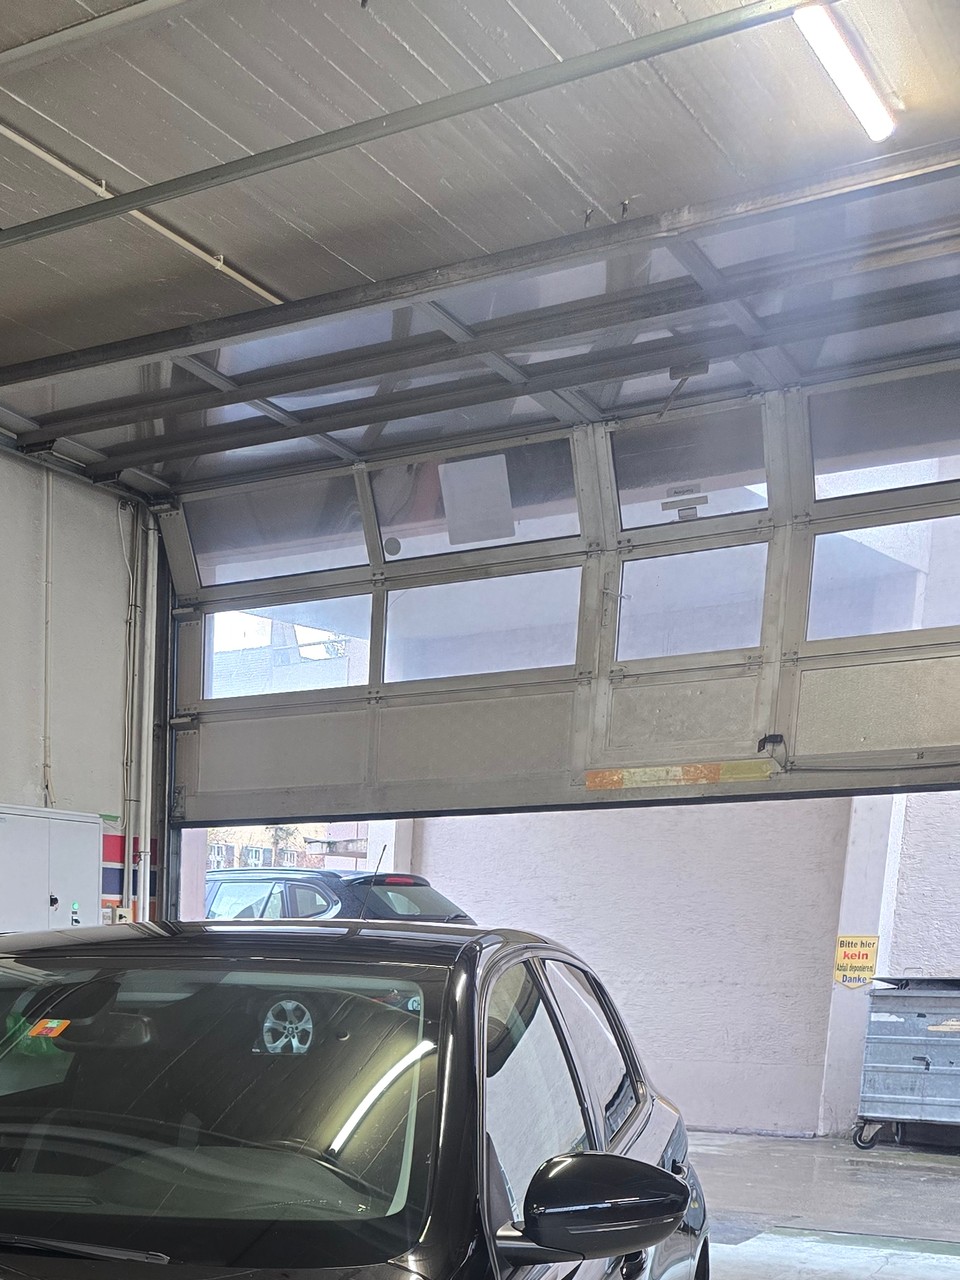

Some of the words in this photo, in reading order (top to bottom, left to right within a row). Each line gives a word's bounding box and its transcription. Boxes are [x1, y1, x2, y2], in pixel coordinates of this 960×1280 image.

[839, 940, 858, 948] Bitte
[860, 940, 876, 948] hier
[843, 951, 869, 960] kein
[842, 974, 867, 983] Danke
